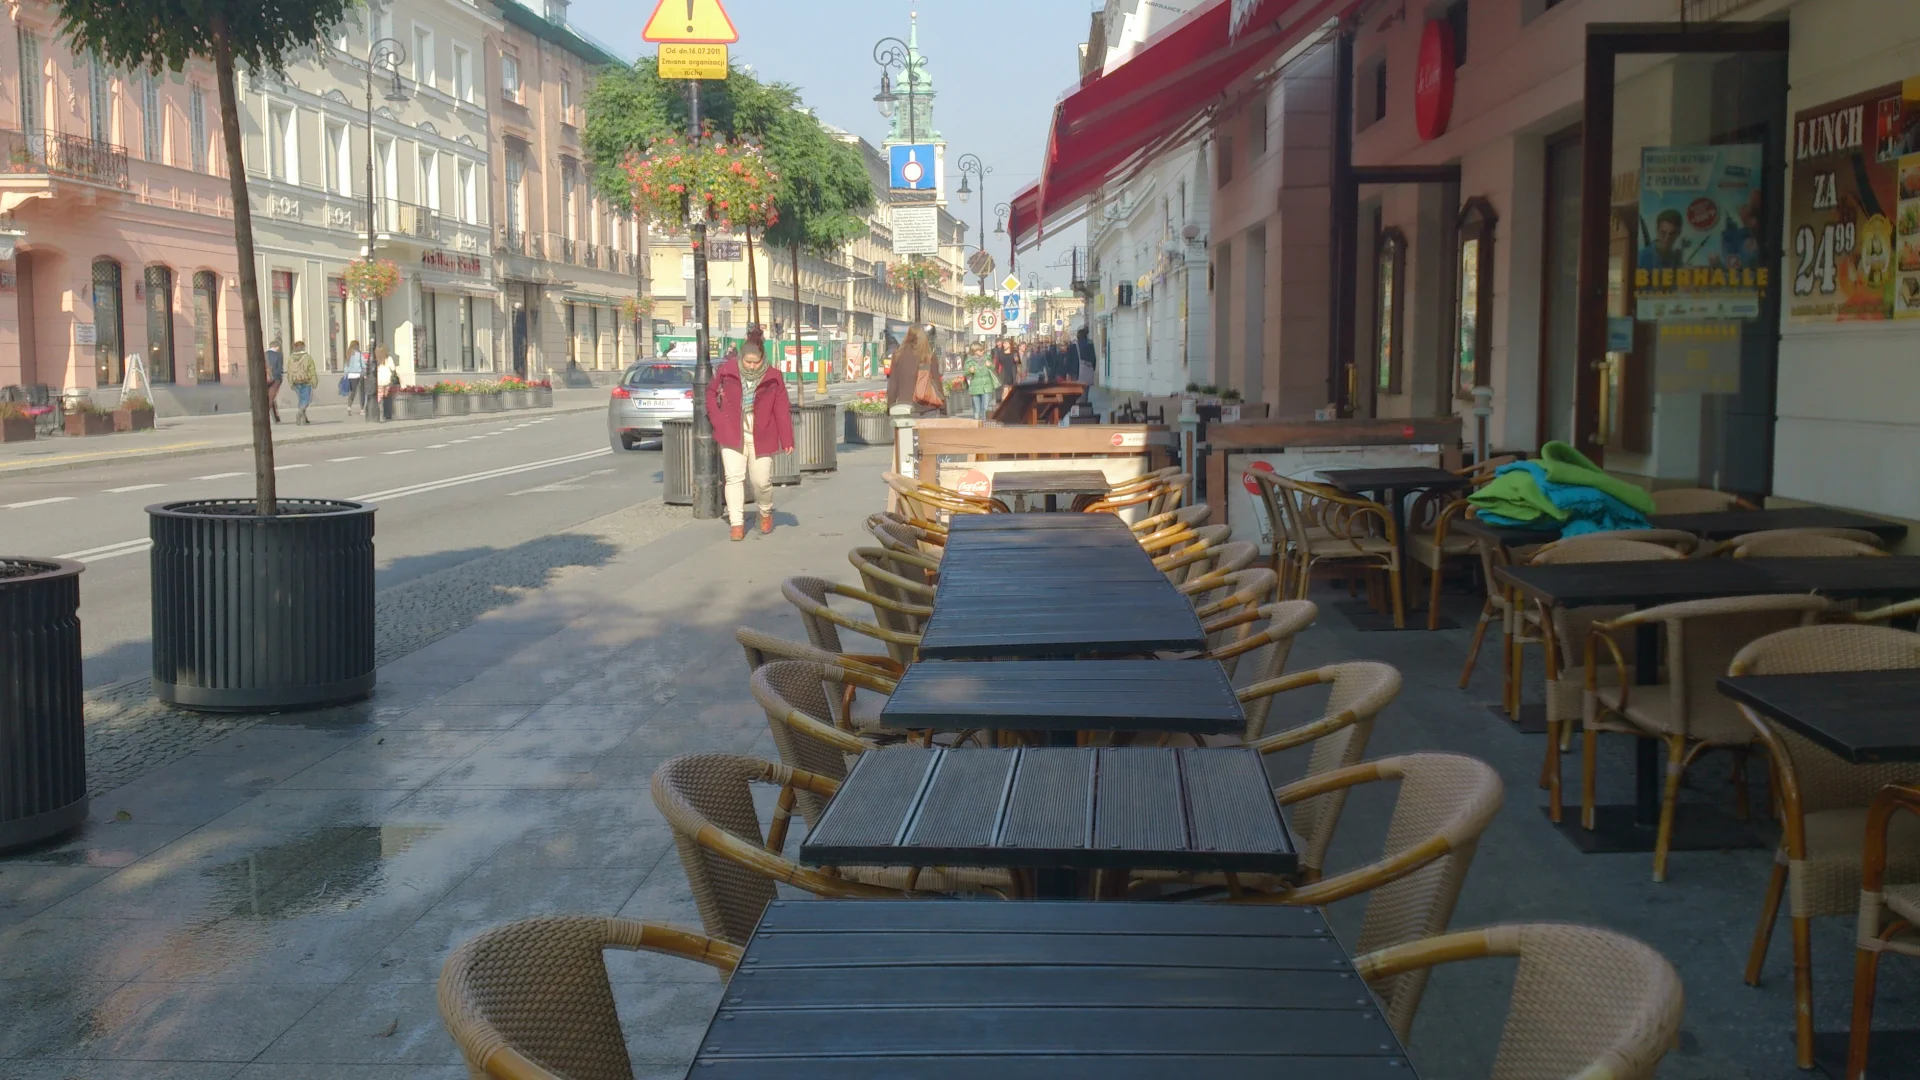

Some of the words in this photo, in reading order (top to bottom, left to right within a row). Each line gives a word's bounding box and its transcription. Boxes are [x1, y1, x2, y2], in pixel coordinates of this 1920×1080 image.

[688, 59, 725, 67] organizacji
[1797, 104, 1865, 160] LUNCH
[1655, 174, 1700, 186] PAYBACK
[1812, 171, 1838, 208] ZA
[1634, 267, 1768, 287] BIERHALLE
[980, 315, 994, 325] 50
